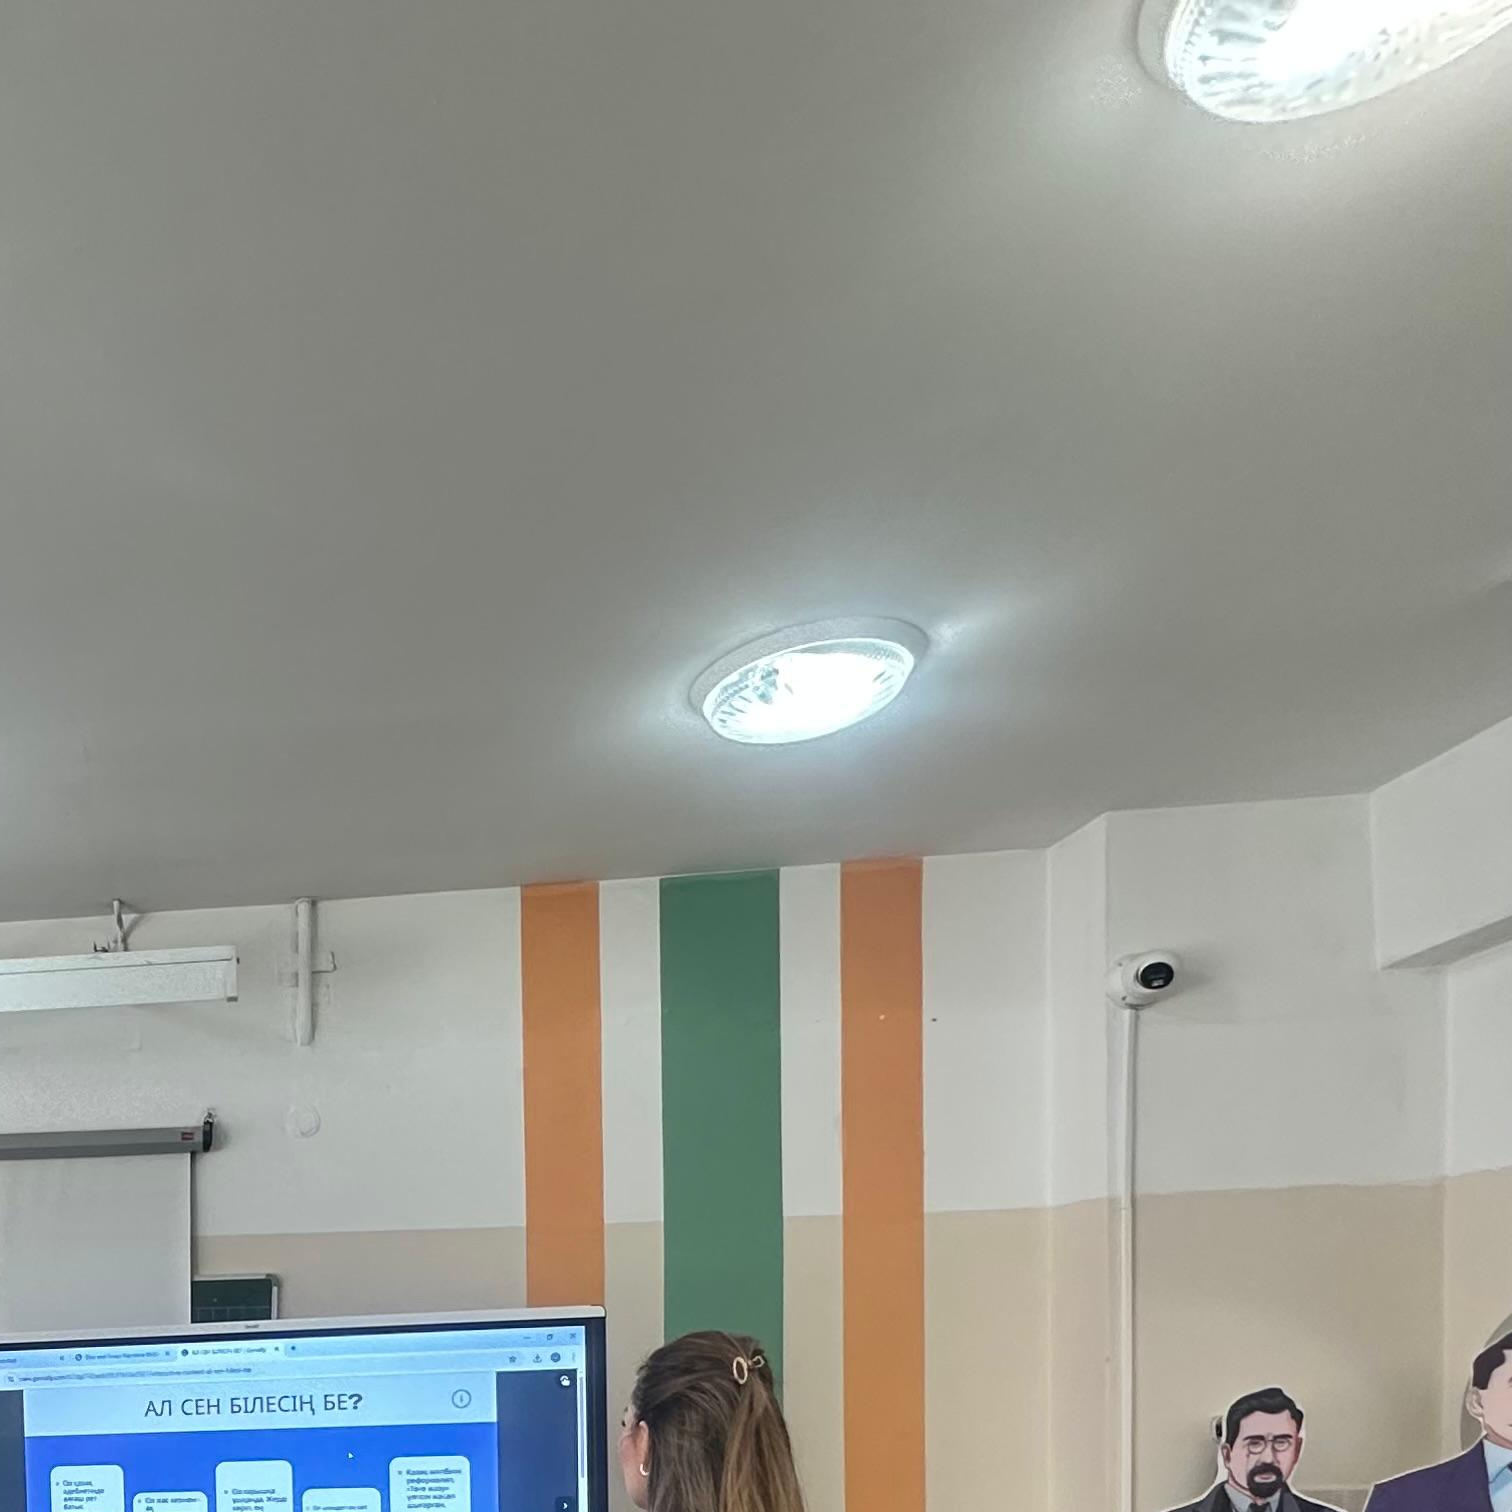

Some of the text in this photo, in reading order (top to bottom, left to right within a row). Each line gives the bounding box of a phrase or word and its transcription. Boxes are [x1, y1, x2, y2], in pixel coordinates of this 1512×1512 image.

[144, 1393, 363, 1417] АЛ СЕН БІЛЕСІҢ БЕ?
